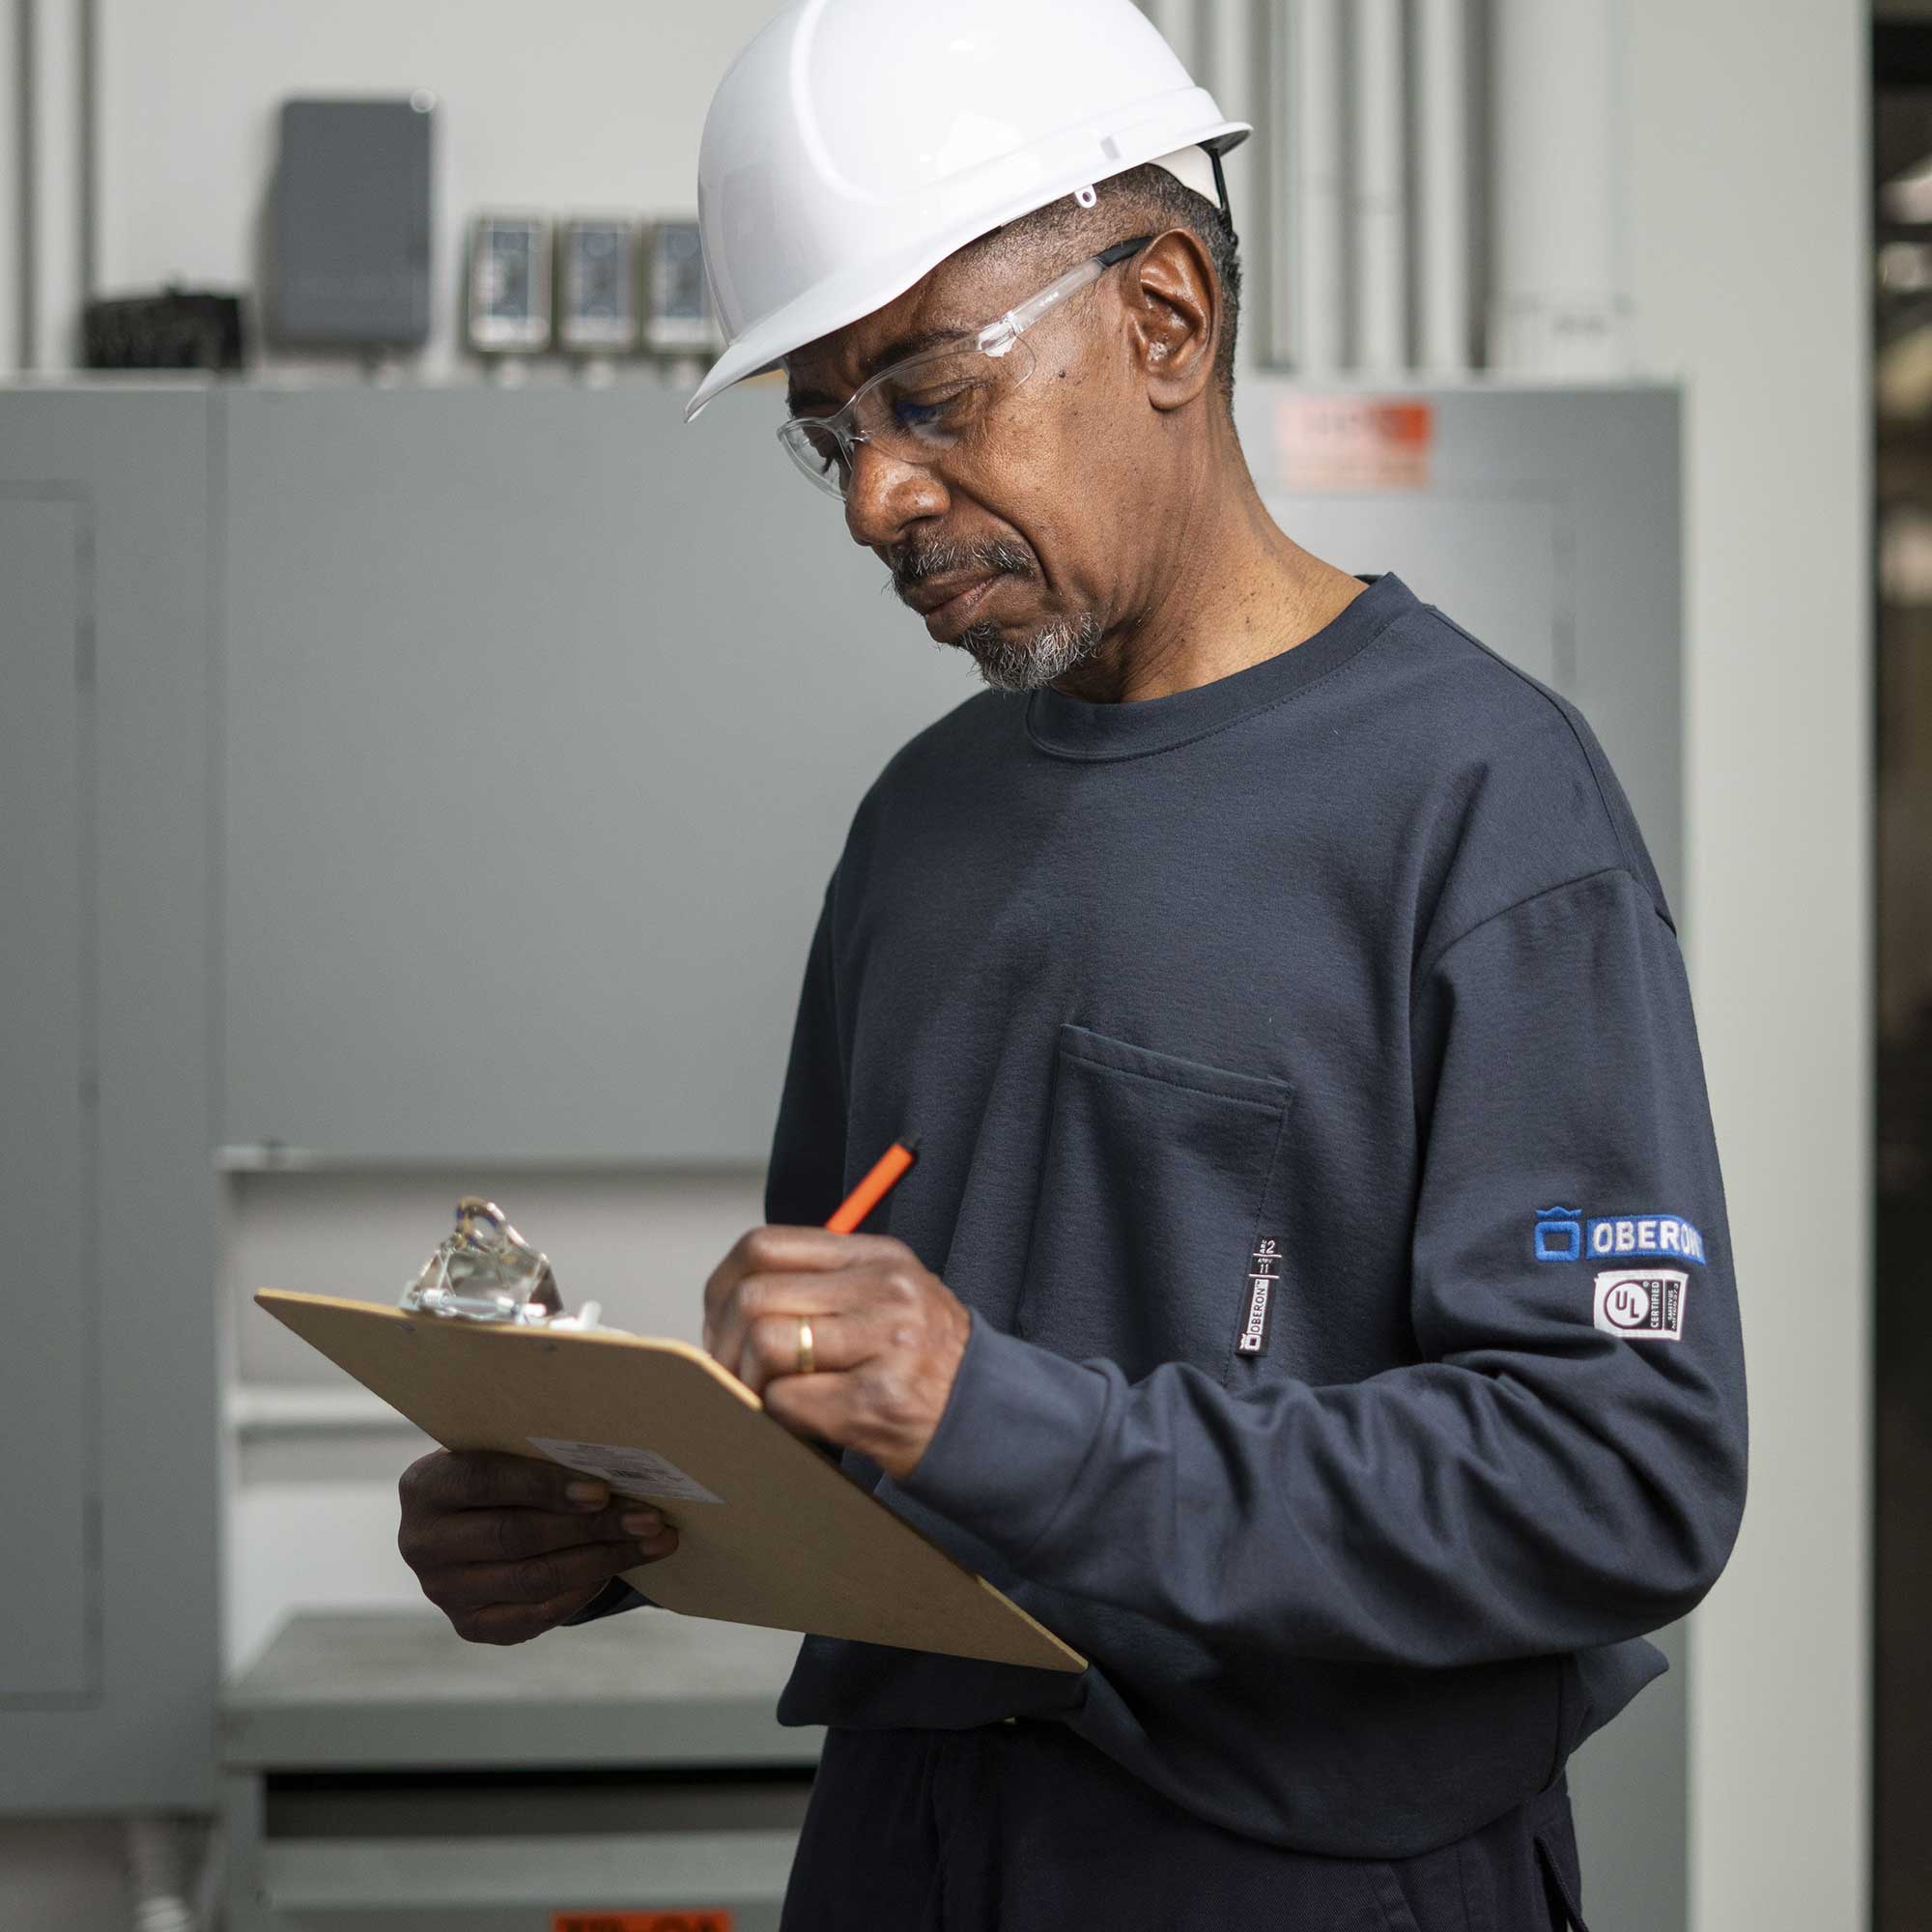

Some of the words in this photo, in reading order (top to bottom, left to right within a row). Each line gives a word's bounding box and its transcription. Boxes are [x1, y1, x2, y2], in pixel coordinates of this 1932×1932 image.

[1265, 1240, 1275, 1254] 2
[1592, 1221, 1700, 1258] OBERON
[1260, 1264, 1269, 1274] 11
[1615, 1291, 1639, 1319] UL
[1650, 1281, 1660, 1328] CERTIFIED
